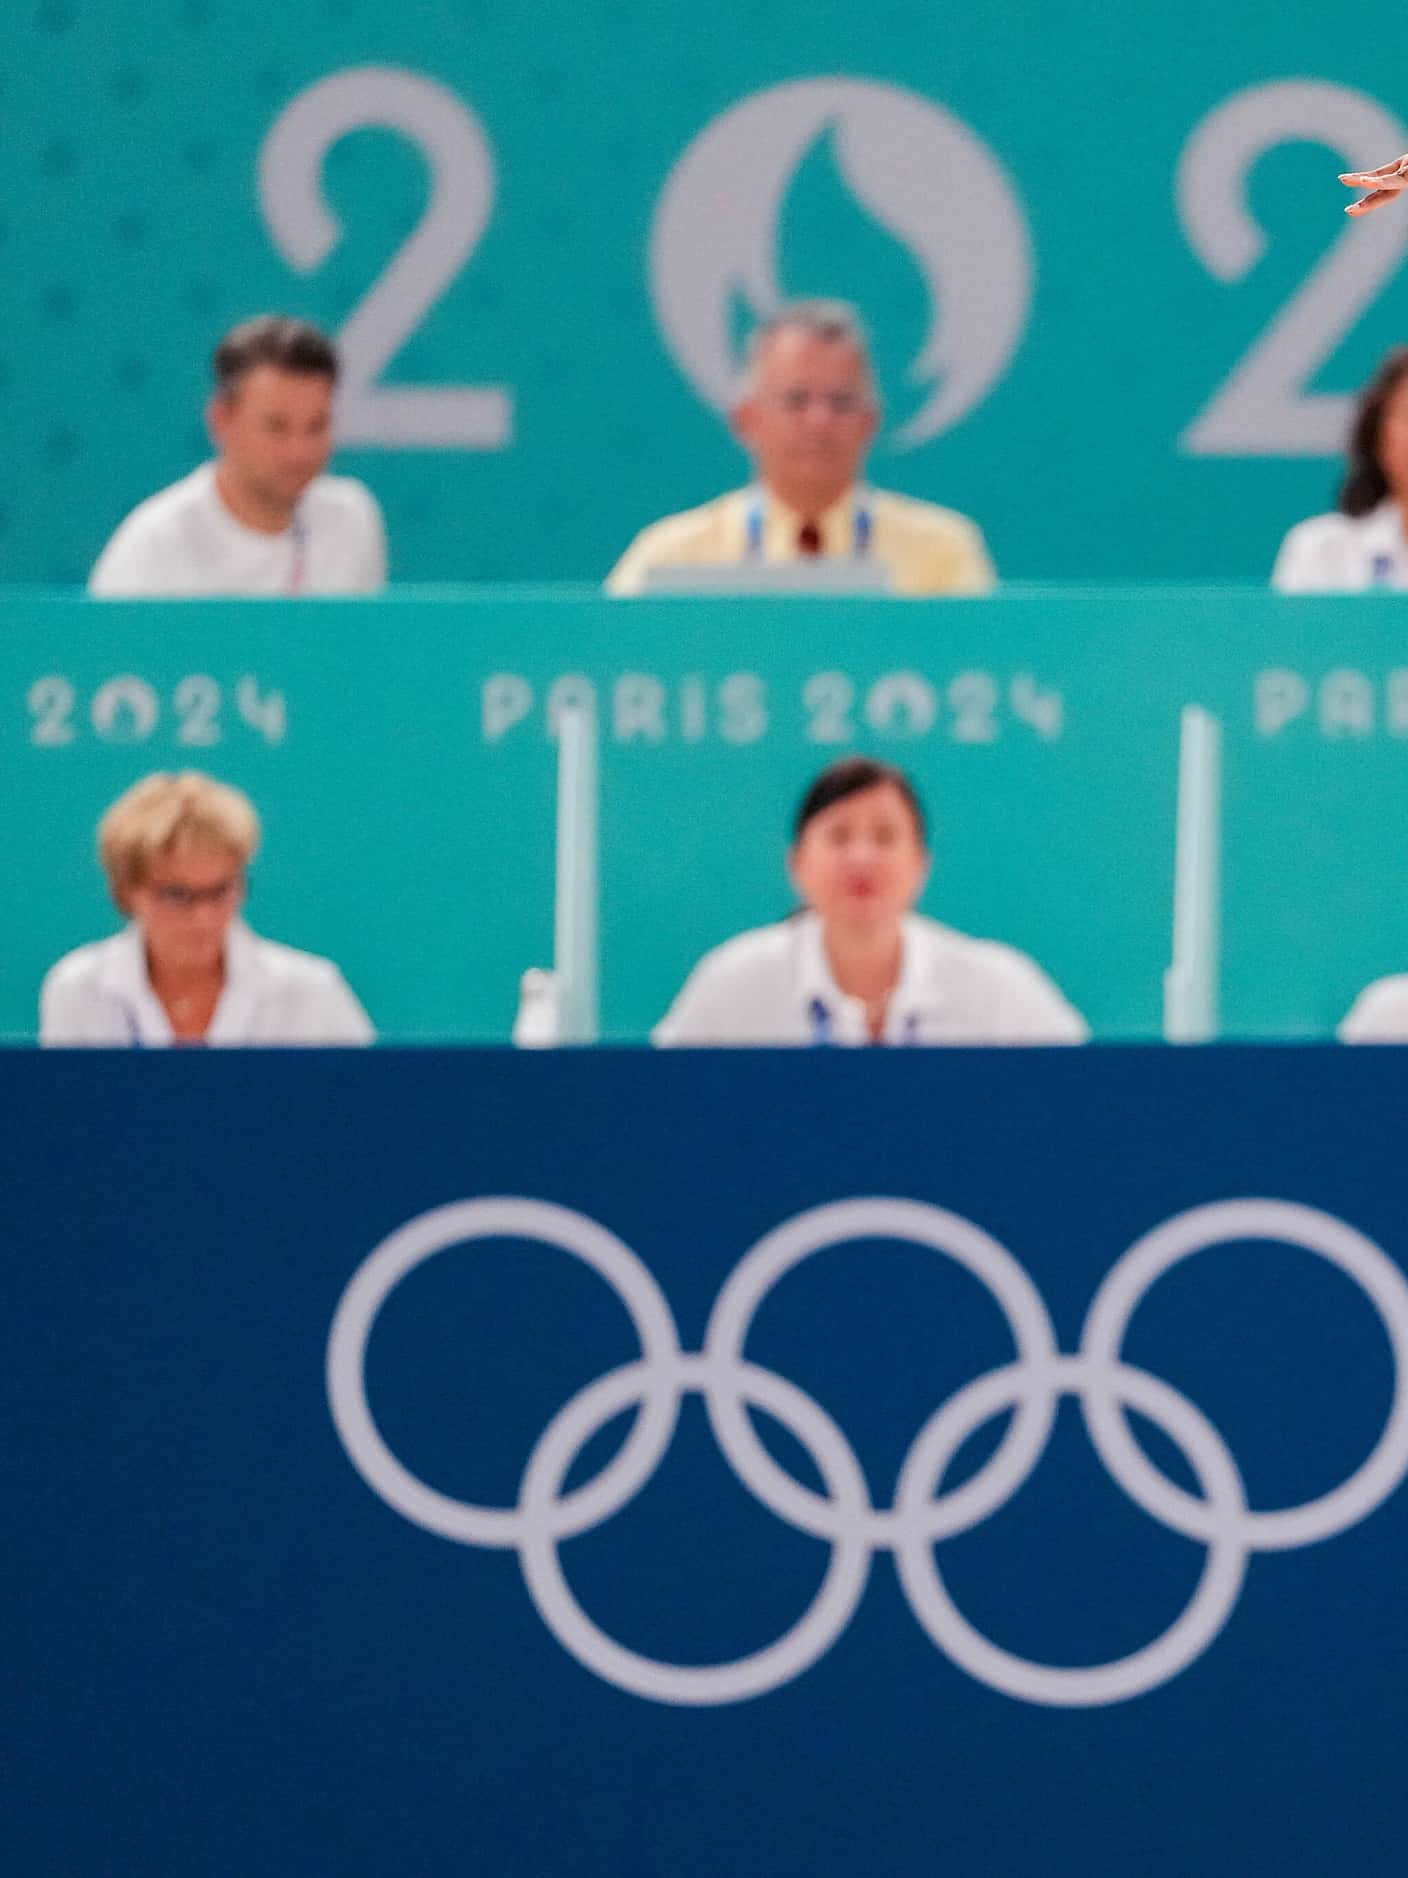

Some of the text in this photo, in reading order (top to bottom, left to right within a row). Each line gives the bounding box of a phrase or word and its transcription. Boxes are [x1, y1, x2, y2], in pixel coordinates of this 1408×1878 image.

[28, 673, 287, 746] 2024
[482, 670, 1062, 745] PARIS 2024
